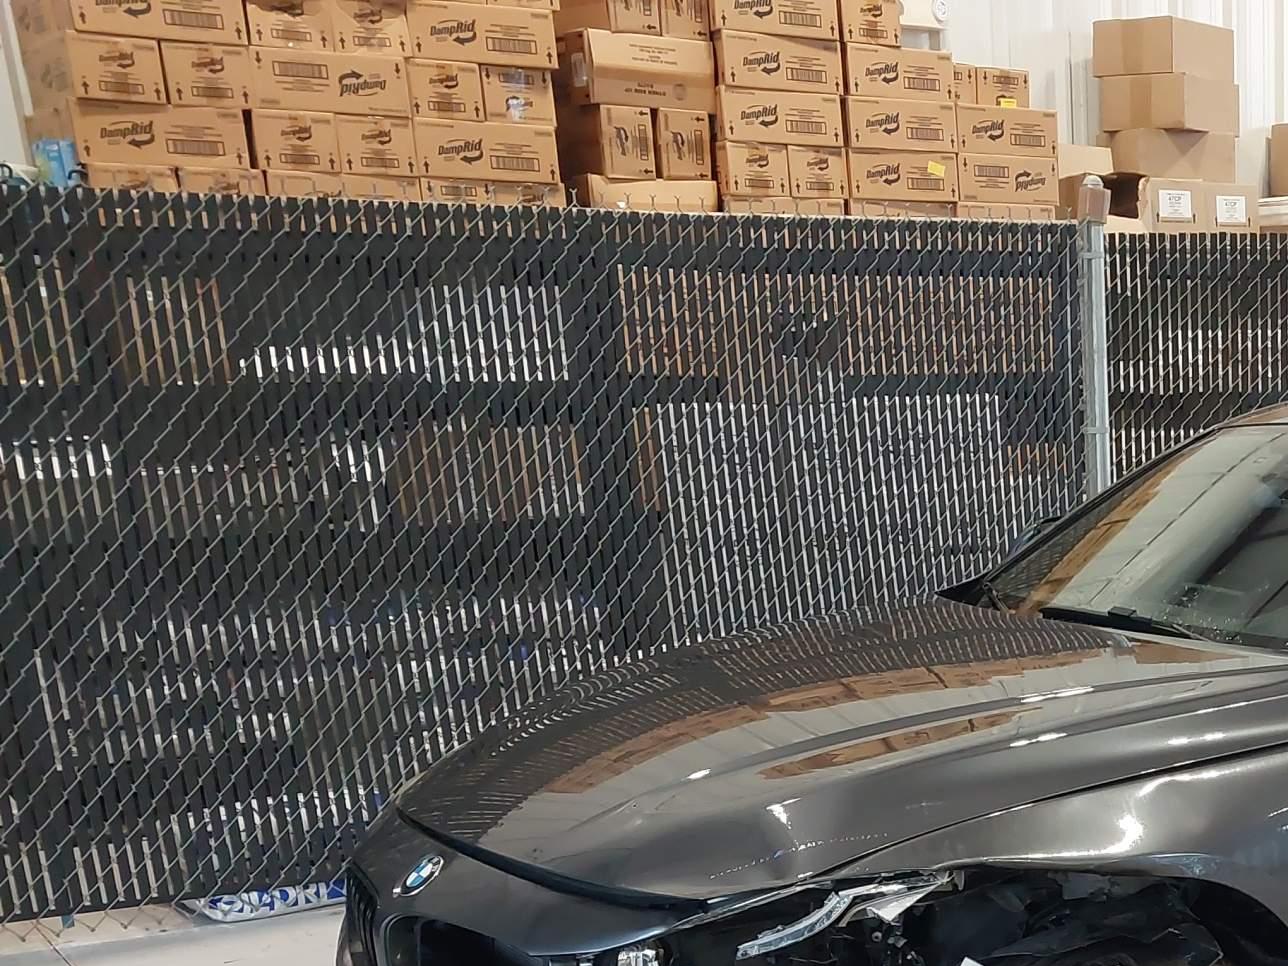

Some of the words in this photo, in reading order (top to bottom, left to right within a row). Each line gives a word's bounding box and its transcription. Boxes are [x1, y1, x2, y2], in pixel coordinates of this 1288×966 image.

[430, 19, 476, 37] DampRid
[743, 51, 780, 67] DampRid
[865, 62, 899, 78] DampRid
[340, 79, 387, 97] DampRid
[740, 104, 778, 121] DampRid
[865, 112, 900, 128] DampRid
[100, 120, 154, 139] DampRid
[972, 119, 1005, 134] DampRid
[438, 138, 483, 156] DampRid
[866, 163, 900, 179] DampRid
[1015, 176, 1046, 192] DampRid
